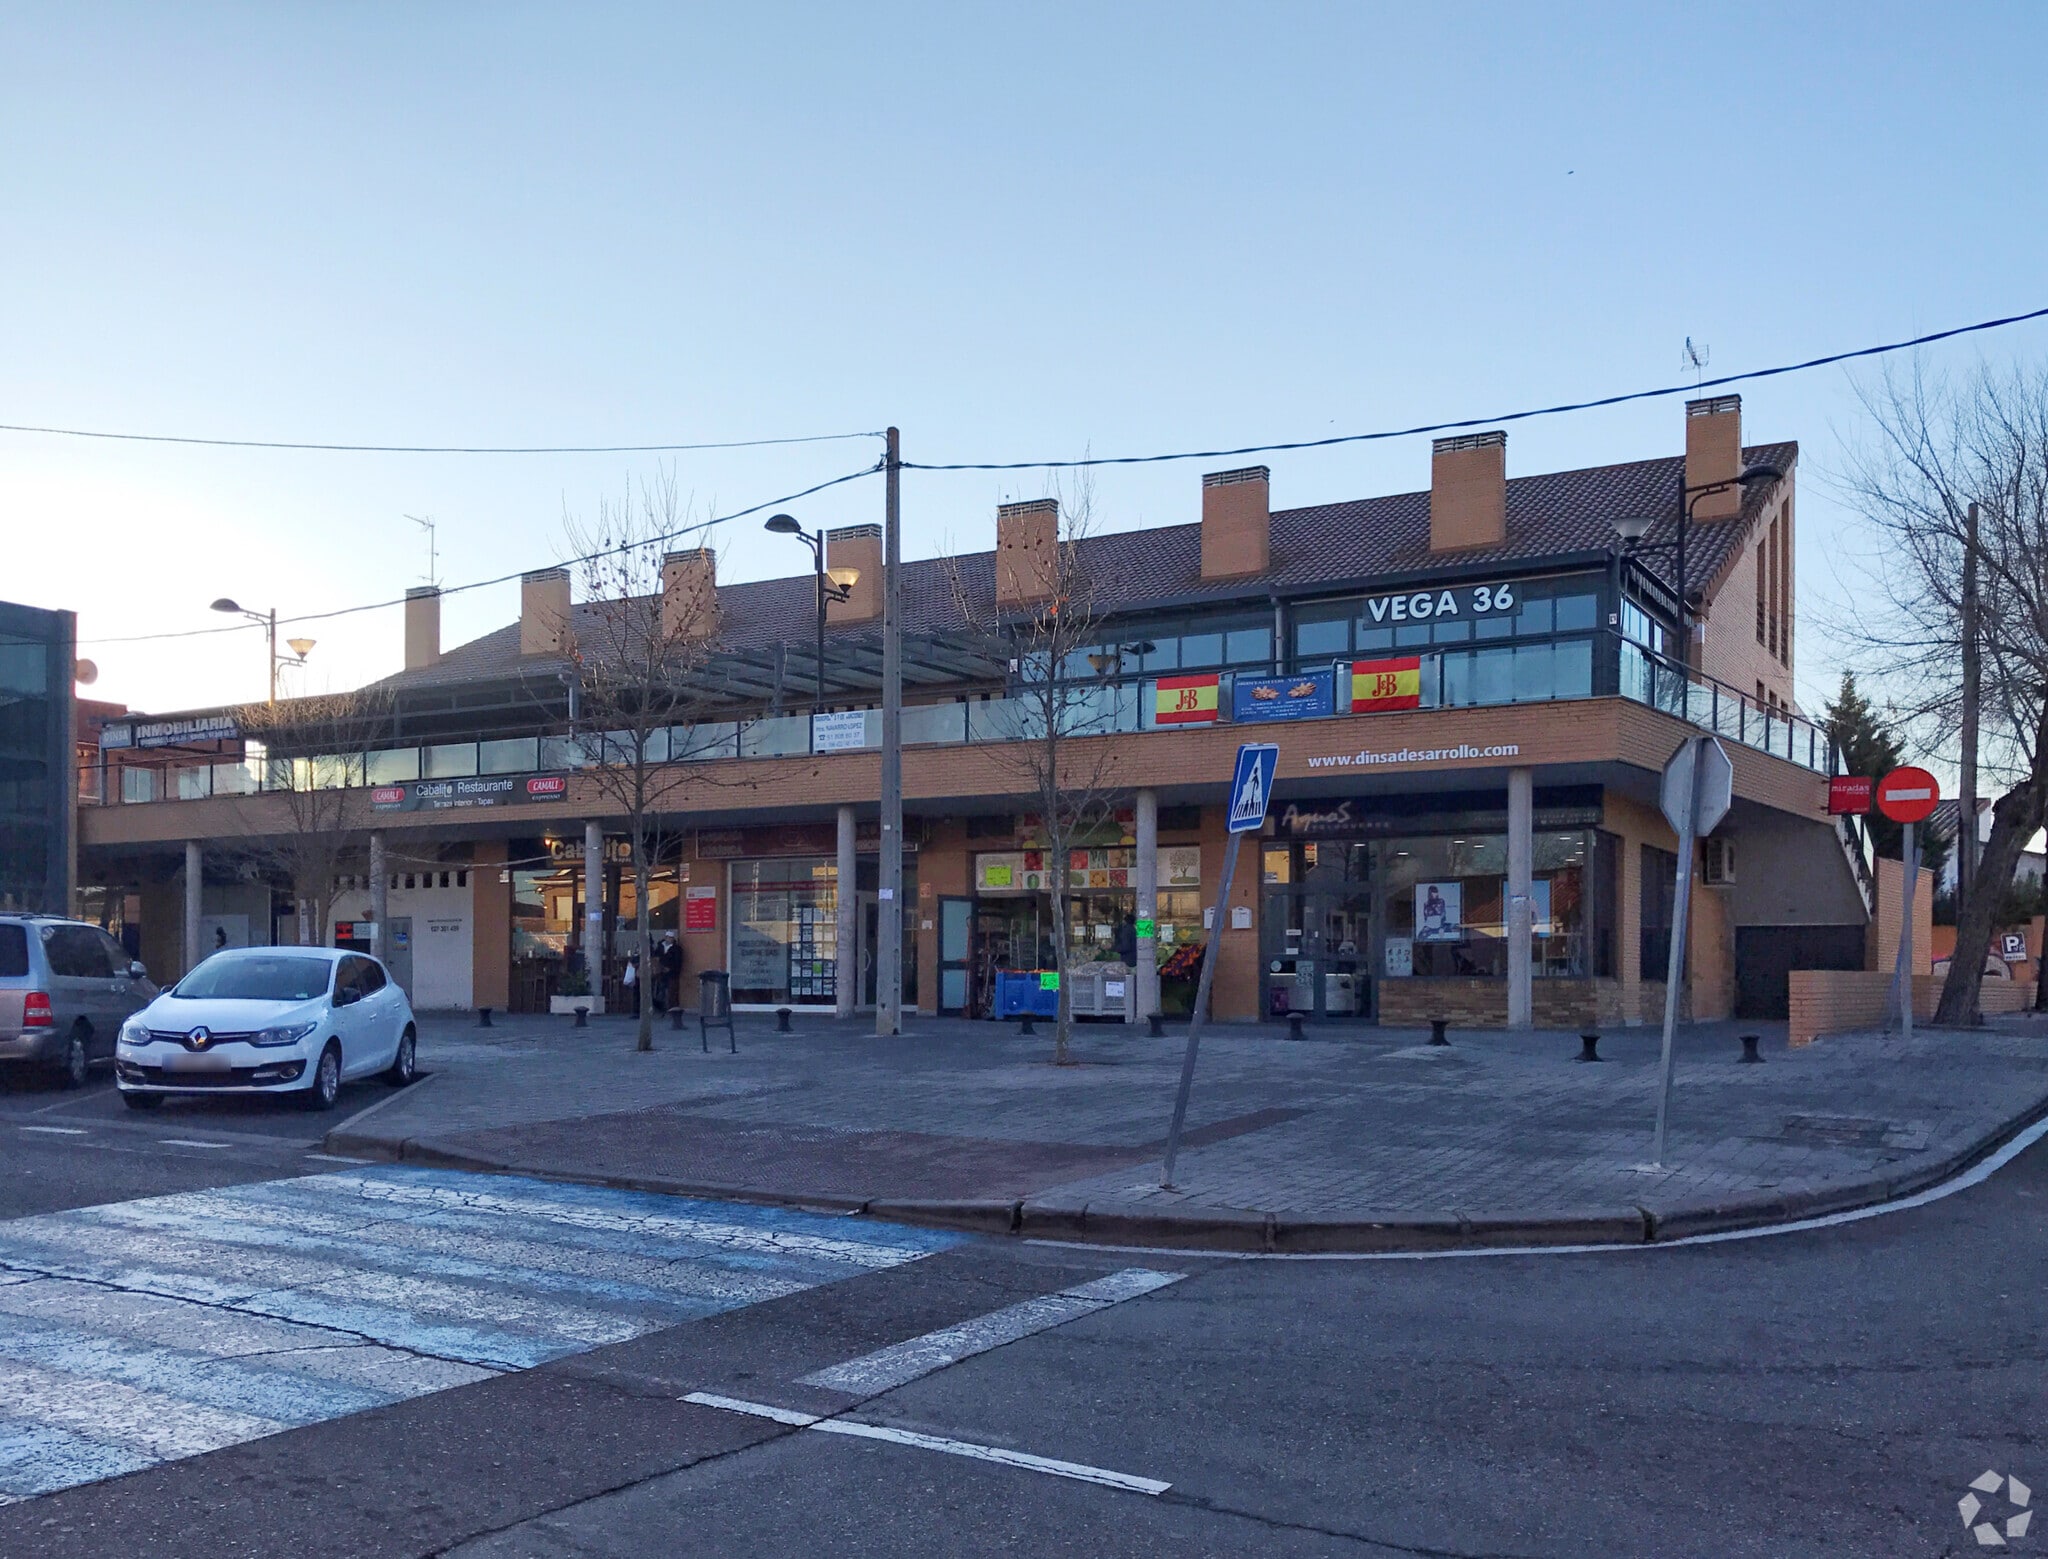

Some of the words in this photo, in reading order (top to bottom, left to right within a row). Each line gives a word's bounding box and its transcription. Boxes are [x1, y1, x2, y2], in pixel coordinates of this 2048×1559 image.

[1368, 590, 1458, 622] VEGA
[1472, 583, 1514, 612] 36
[1372, 673, 1397, 697] J&B
[1175, 689, 1198, 710] J&B
[137, 717, 234, 738] INMOBILIARIA
[1308, 744, 1519, 768] www.dinsadesarrollo.com
[416, 783, 453, 798] Cabalito
[458, 779, 513, 794] Restaurante
[532, 778, 559, 791] CAMALI
[1831, 784, 1870, 792] miradas
[376, 788, 399, 801] CAMALI
[477, 797, 494, 807] Tapas
[2005, 936, 2019, 951] P
